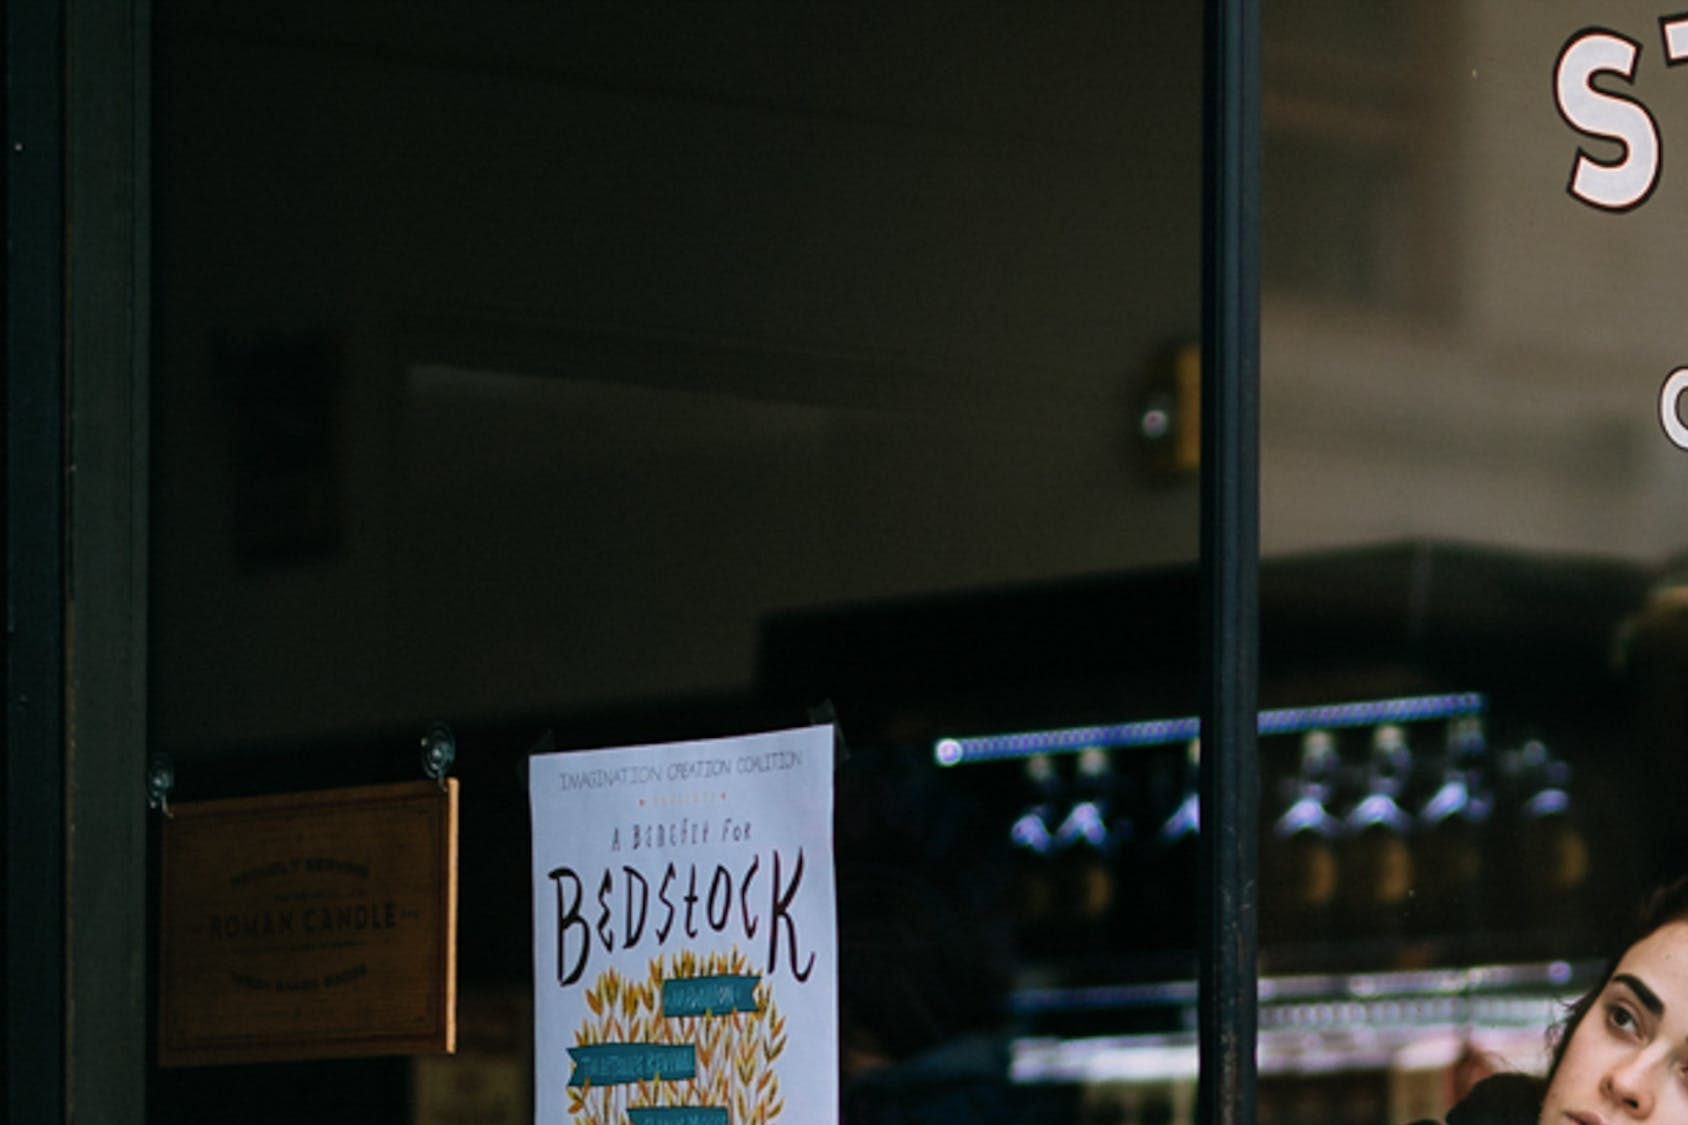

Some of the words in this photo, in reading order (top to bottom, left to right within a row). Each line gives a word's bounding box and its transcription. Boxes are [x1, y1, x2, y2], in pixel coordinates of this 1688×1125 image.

[559, 769, 661, 791] IMAGINATION
[667, 761, 732, 780] CREATION
[737, 751, 803, 774] COALITION
[208, 910, 293, 939] ROMAN
[303, 901, 397, 934] CANDLE
